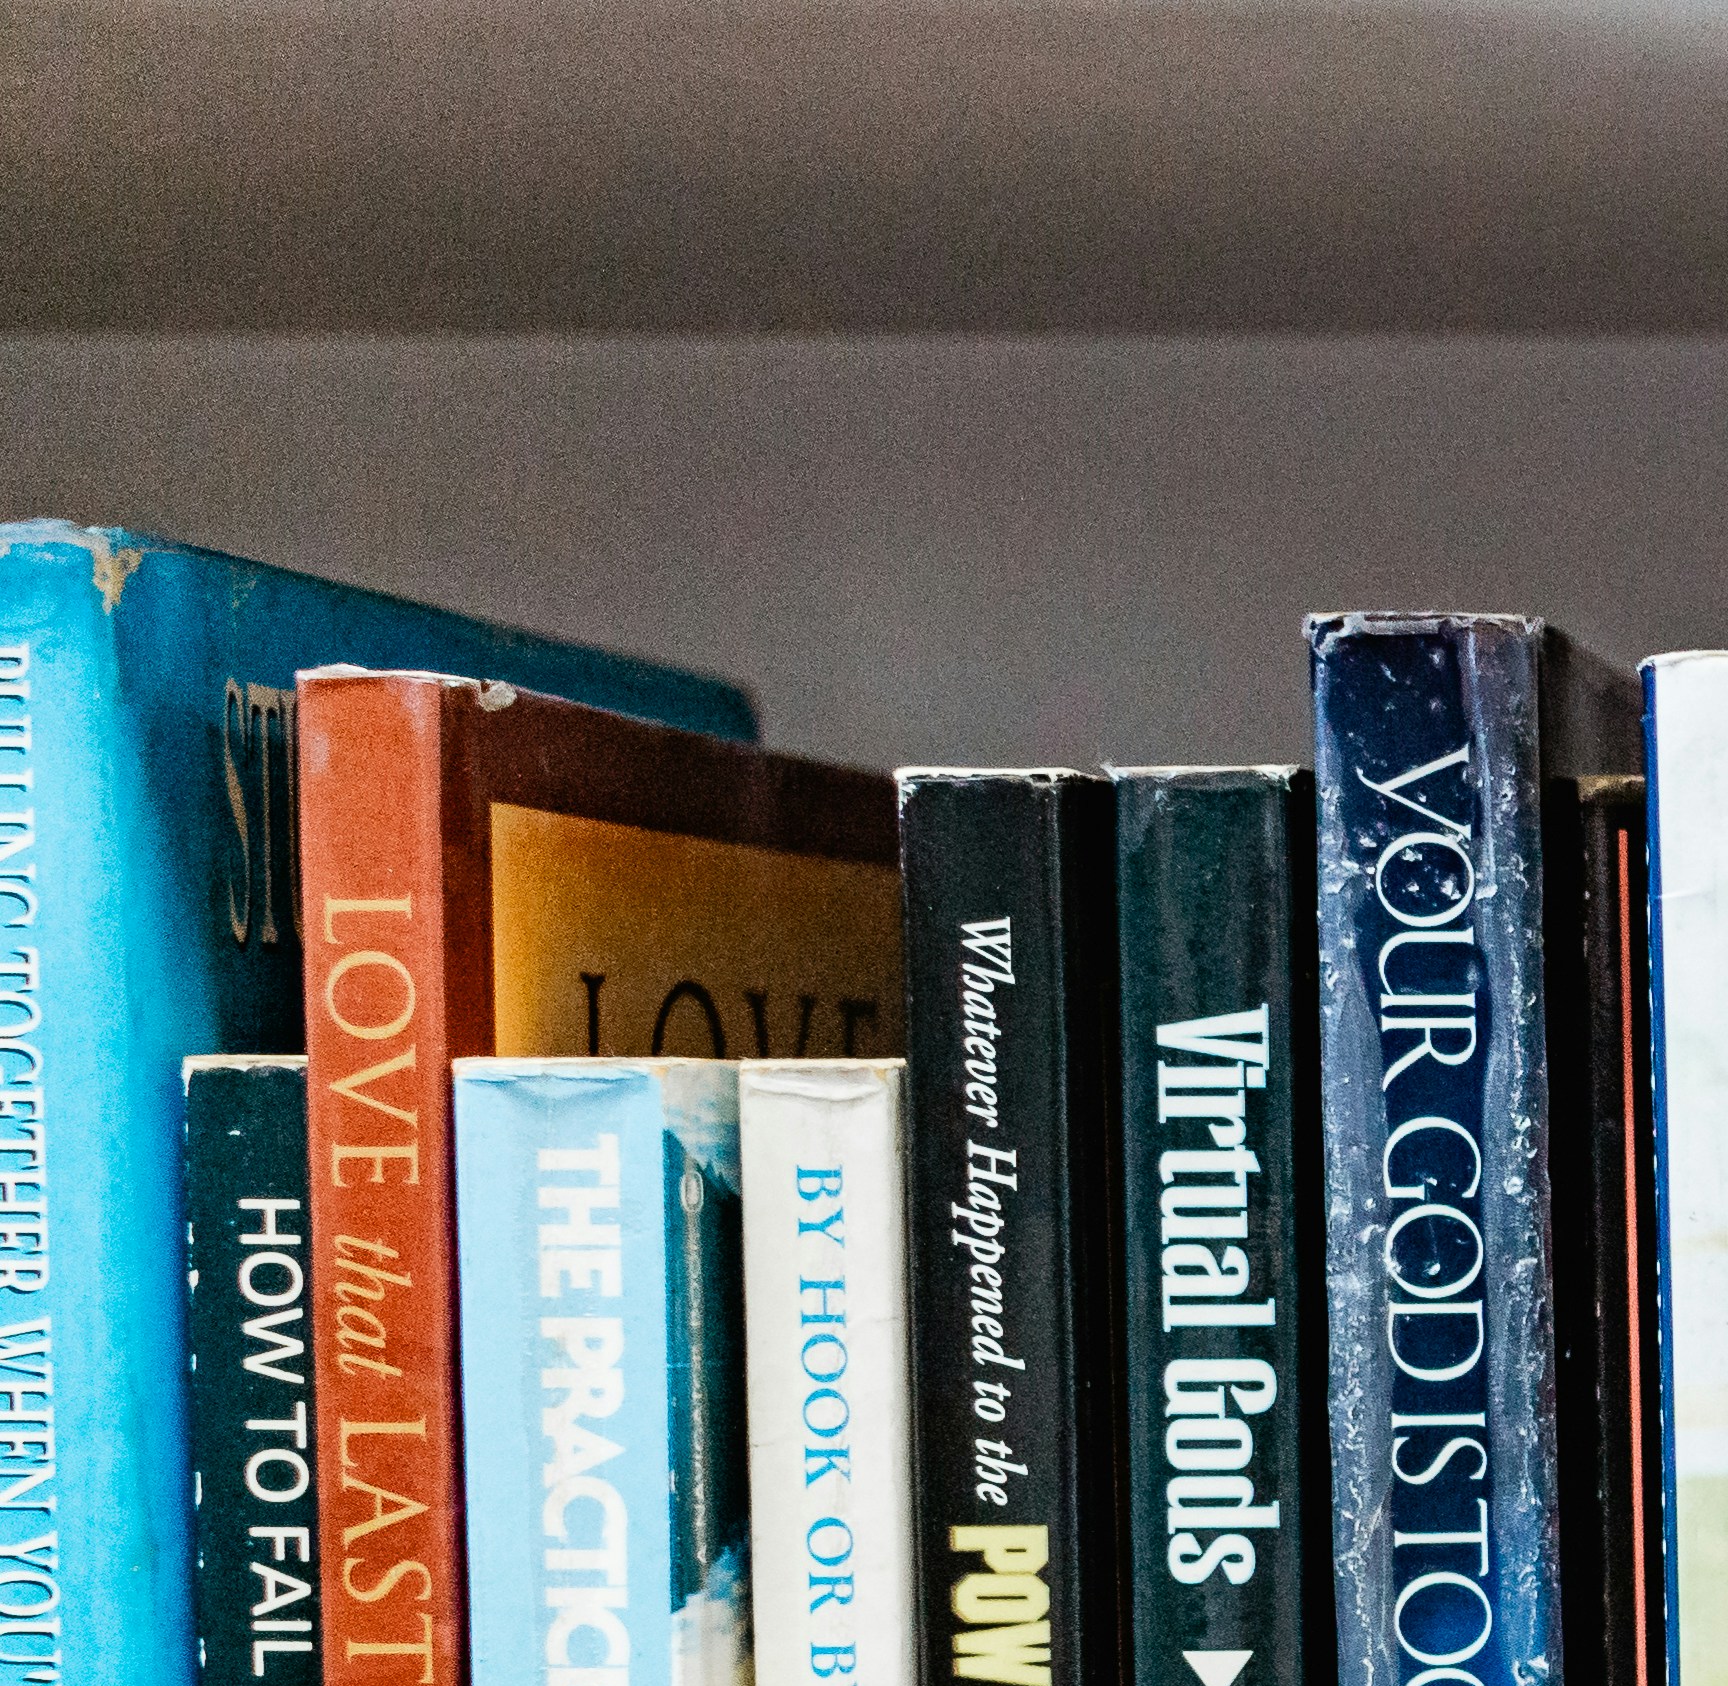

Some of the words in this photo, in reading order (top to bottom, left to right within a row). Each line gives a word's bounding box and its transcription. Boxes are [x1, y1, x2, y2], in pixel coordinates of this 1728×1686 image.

[224, 677, 301, 953] ST
[1356, 743, 1477, 1092] YOUR
[323, 894, 420, 1188] LOVE
[961, 917, 1015, 1130] Whatever
[537, 1133, 624, 1300] THE
[796, 1164, 845, 1247] BY
[951, 1147, 1025, 1374] Happened
[1156, 1003, 1276, 1333] Virtual
[1383, 1117, 1485, 1382] GOD
[238, 1198, 305, 1384] HOW
[330, 1238, 412, 1380] that
[800, 1281, 852, 1486] HOOK
[0, 1317, 57, 1512] WHEN
[243, 1401, 310, 1503] TO
[975, 1379, 1013, 1424] to
[975, 1437, 1029, 1506] the
[1164, 1357, 1280, 1586] Gods
[1390, 1412, 1487, 1486] IS
[250, 1526, 313, 1676] FAIL
[805, 1517, 854, 1614] OR
